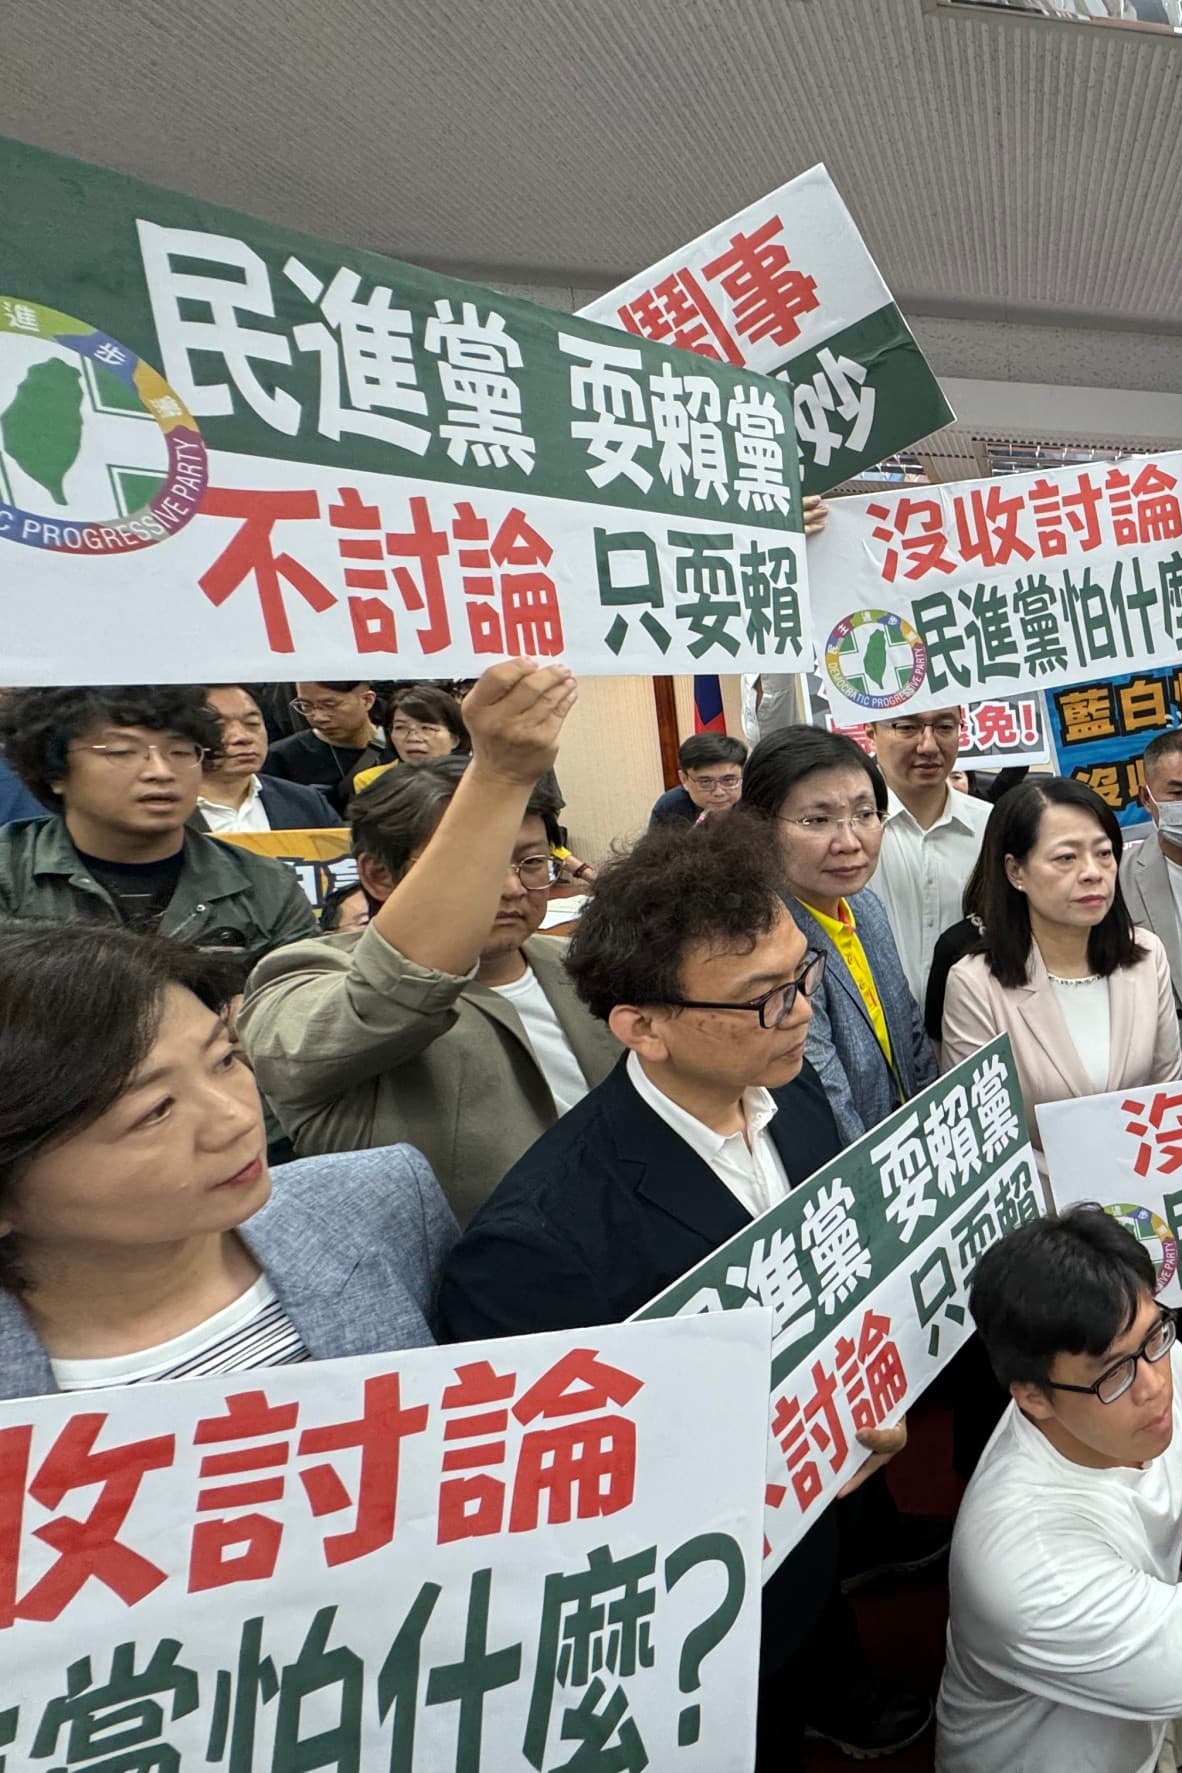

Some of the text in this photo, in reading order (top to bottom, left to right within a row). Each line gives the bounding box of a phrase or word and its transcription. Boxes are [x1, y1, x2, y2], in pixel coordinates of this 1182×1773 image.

[136, 219, 792, 518] 民進黨 耍賴黨
[22, 437, 203, 550] PROGRESSIVE PARTY
[198, 486, 803, 659] 不討論 只耍賴
[914, 647, 927, 675] PARTY
[675, 1054, 1020, 1359] 進黨 耍賴黨
[763, 1308, 908, 1560] 討論
